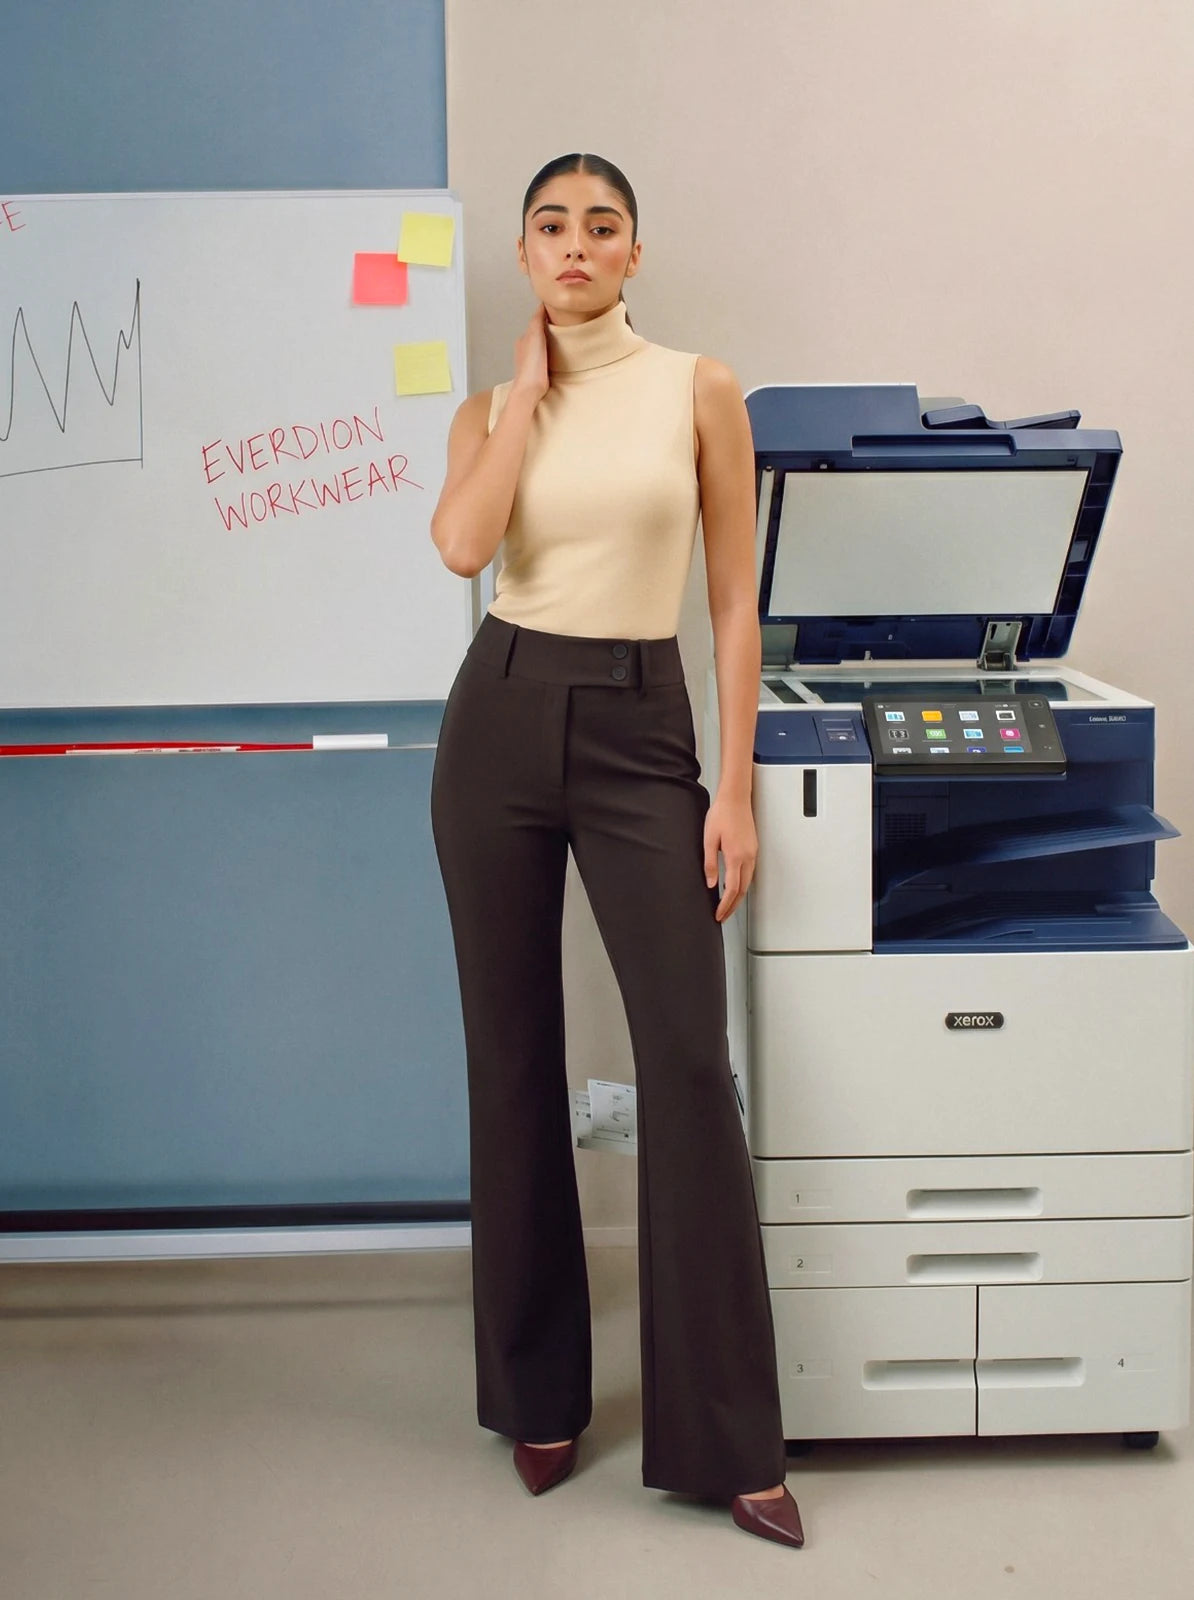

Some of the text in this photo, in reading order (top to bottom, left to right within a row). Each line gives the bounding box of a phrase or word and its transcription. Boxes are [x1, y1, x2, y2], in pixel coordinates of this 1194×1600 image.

[0, 200, 27, 232] E
[202, 406, 384, 483] EVERDION
[214, 454, 425, 530] WORKWEAR
[953, 1015, 995, 1027] xerox
[795, 1193, 800, 1204] 1
[796, 1258, 804, 1269] 2
[1117, 1357, 1125, 1368] 4
[796, 1363, 804, 1374] 3
